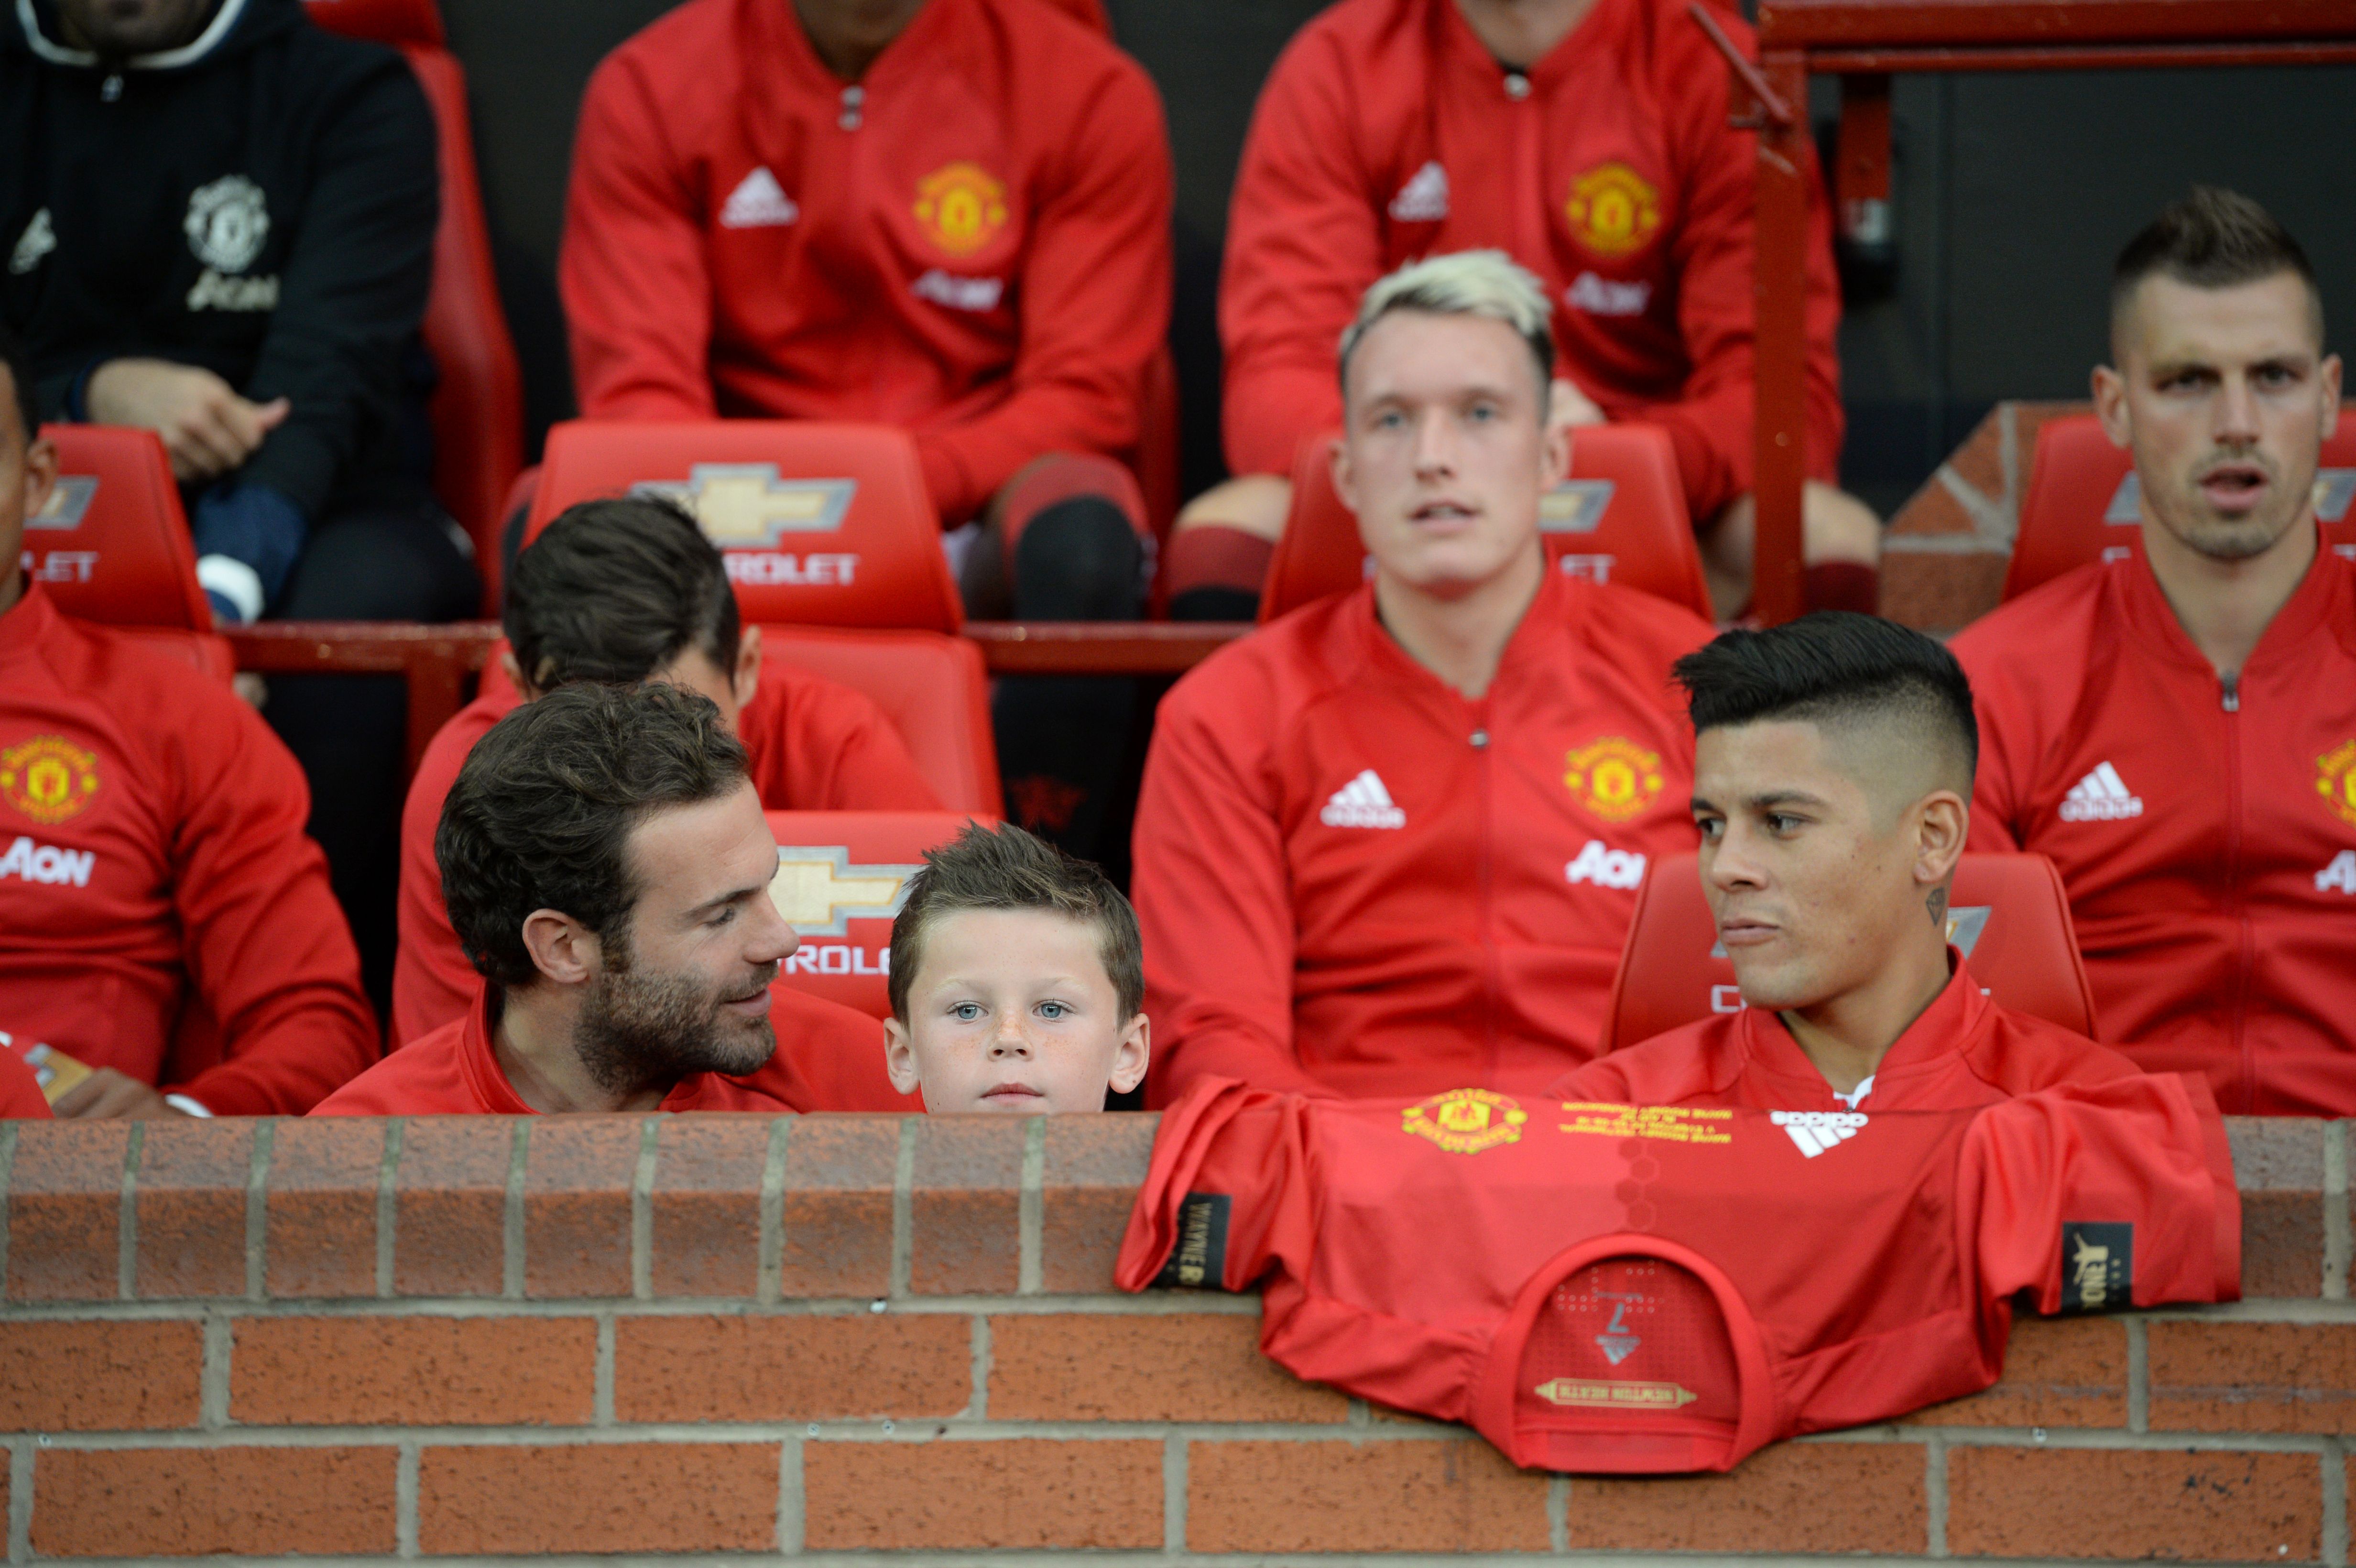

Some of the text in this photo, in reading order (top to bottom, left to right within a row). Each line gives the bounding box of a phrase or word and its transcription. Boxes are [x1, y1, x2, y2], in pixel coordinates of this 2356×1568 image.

[722, 553, 860, 586] ROLET
[1770, 1110, 1869, 1129] adidas
[1607, 1302, 1629, 1333] 7
